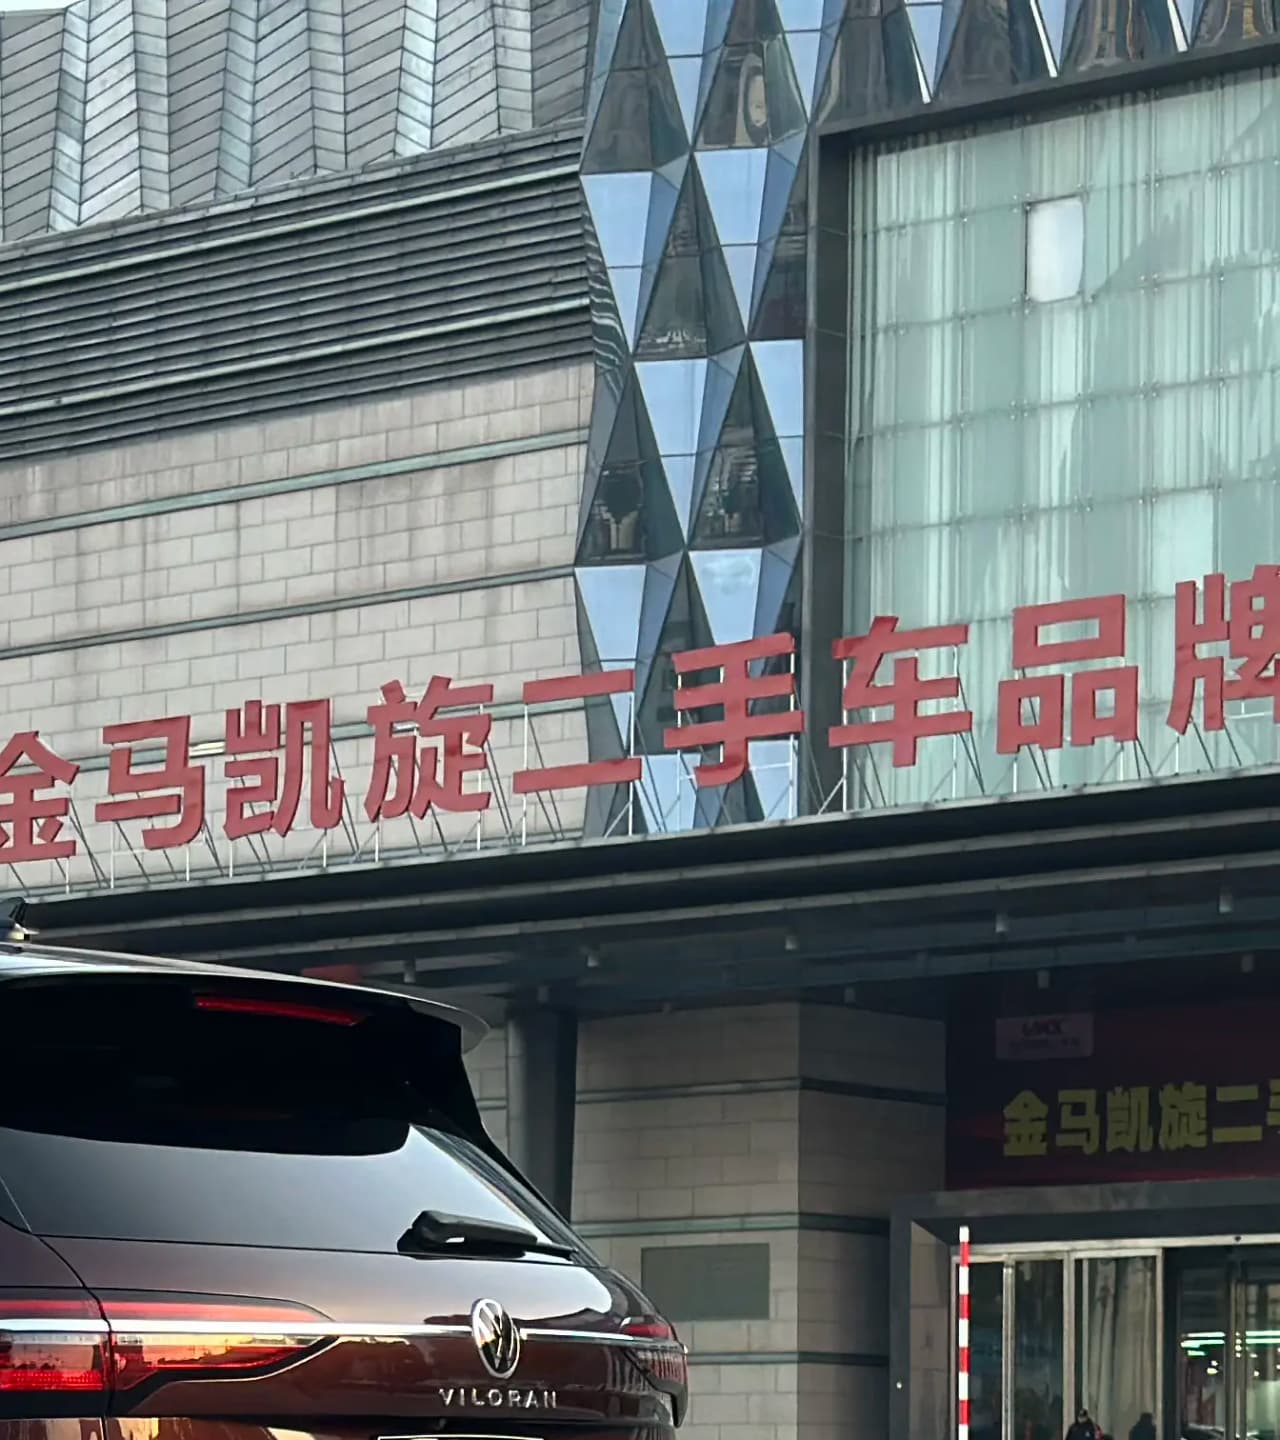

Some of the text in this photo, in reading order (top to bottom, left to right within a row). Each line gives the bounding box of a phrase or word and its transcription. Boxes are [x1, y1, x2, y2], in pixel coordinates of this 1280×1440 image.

[1003, 1078, 1280, 1156] 金马凯旋二
[439, 1388, 557, 1408] VILORAN
